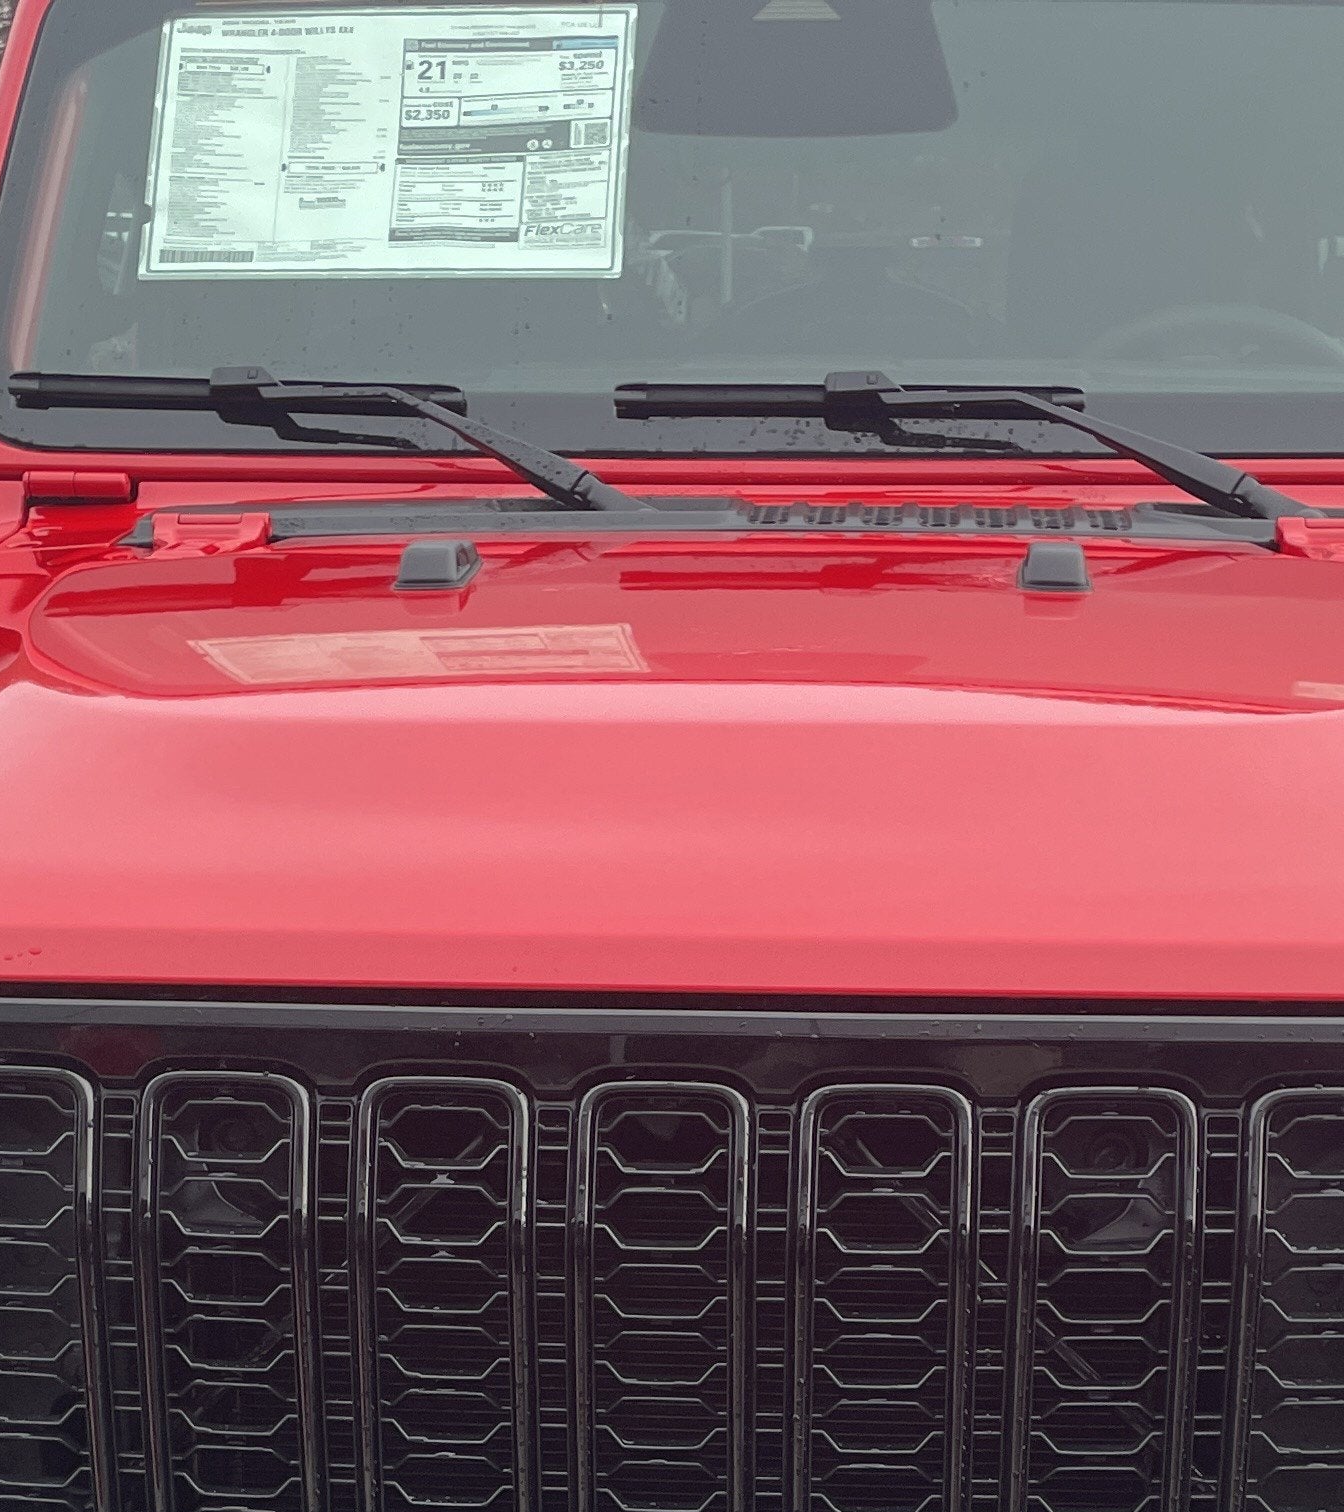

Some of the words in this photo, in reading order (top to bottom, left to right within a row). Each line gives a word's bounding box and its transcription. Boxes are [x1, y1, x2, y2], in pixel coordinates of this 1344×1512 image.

[417, 59, 446, 80] 21
[404, 109, 450, 122] $2,350
[524, 222, 602, 237] FlexCare
